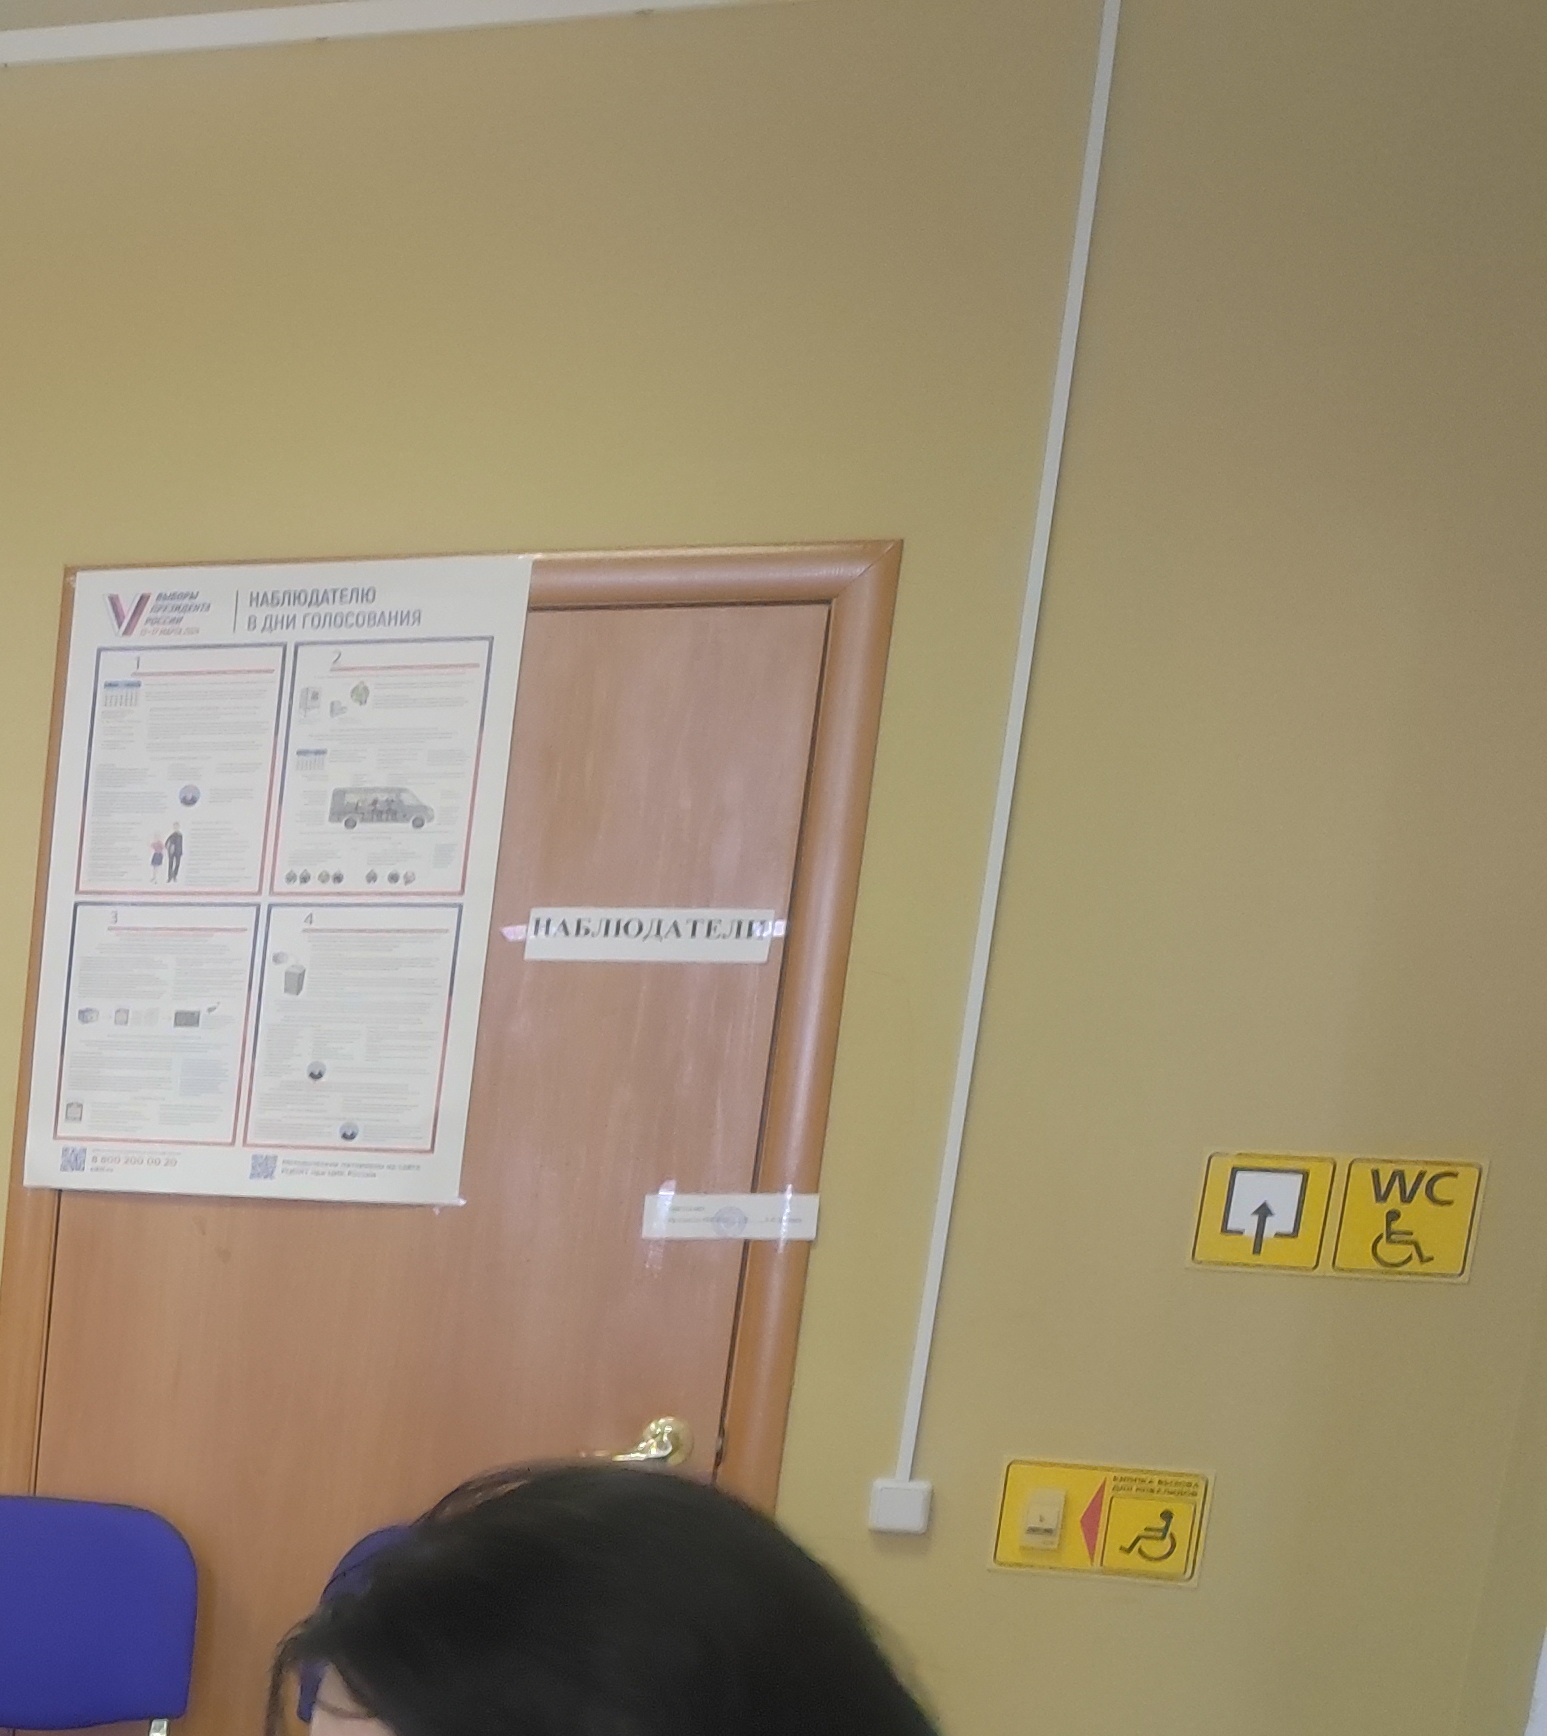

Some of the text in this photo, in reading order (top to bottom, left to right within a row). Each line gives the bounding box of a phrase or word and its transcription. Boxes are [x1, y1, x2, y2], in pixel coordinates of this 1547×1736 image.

[249, 586, 376, 608] НАБЛЮДАТЕЛЮ
[247, 609, 422, 633] В ДНИ ГОЛОСОВАНИЯ
[533, 917, 767, 942] НАБЛЮДАТЕЛИ
[1371, 1168, 1459, 1206] WC
